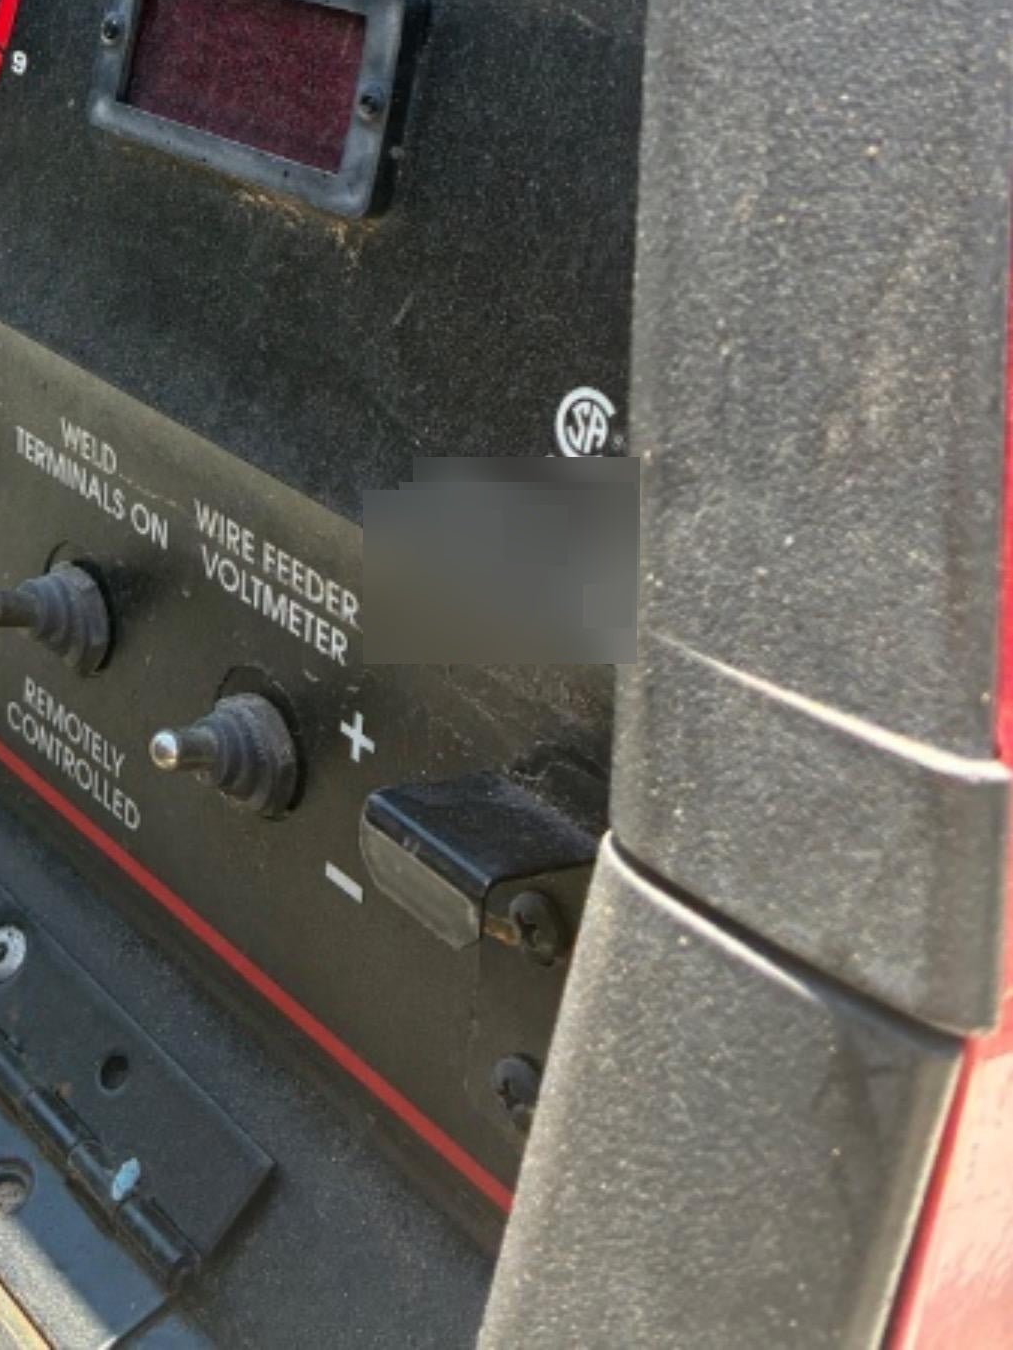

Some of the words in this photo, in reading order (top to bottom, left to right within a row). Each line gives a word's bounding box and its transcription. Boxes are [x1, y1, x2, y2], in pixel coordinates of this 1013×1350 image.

[10, 50, 27, 76] 9
[16, 425, 125, 521] TERMINALS
[131, 503, 169, 550] ON
[60, 416, 117, 475] WELD
[193, 497, 256, 566] WIRE
[262, 539, 362, 630] FEEDER
[200, 543, 348, 668] VOLTMETER
[7, 700, 141, 831] CONTROLLED
[24, 675, 126, 779] REMOTELY
